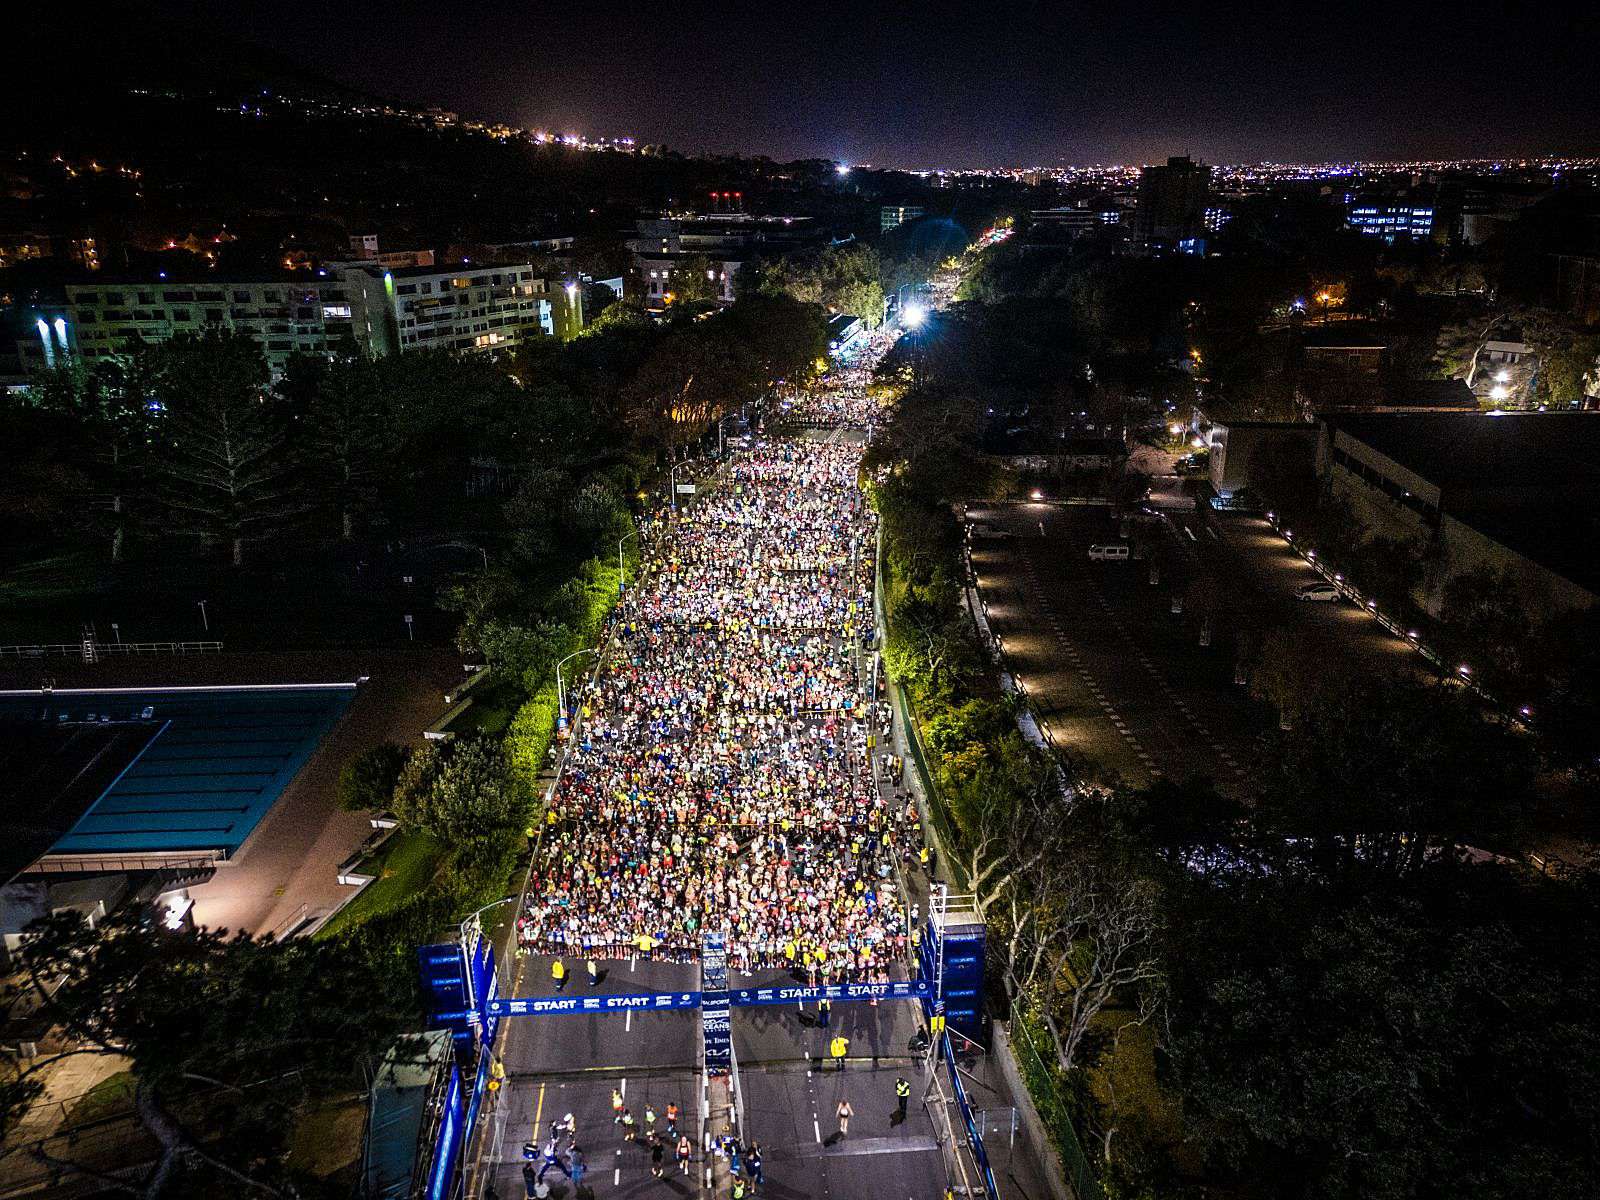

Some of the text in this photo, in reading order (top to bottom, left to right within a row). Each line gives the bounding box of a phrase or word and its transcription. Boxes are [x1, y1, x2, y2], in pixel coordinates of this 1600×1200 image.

[780, 988, 819, 998] START
[848, 985, 888, 995] START
[534, 1000, 576, 1011] START
[607, 997, 649, 1006] START
